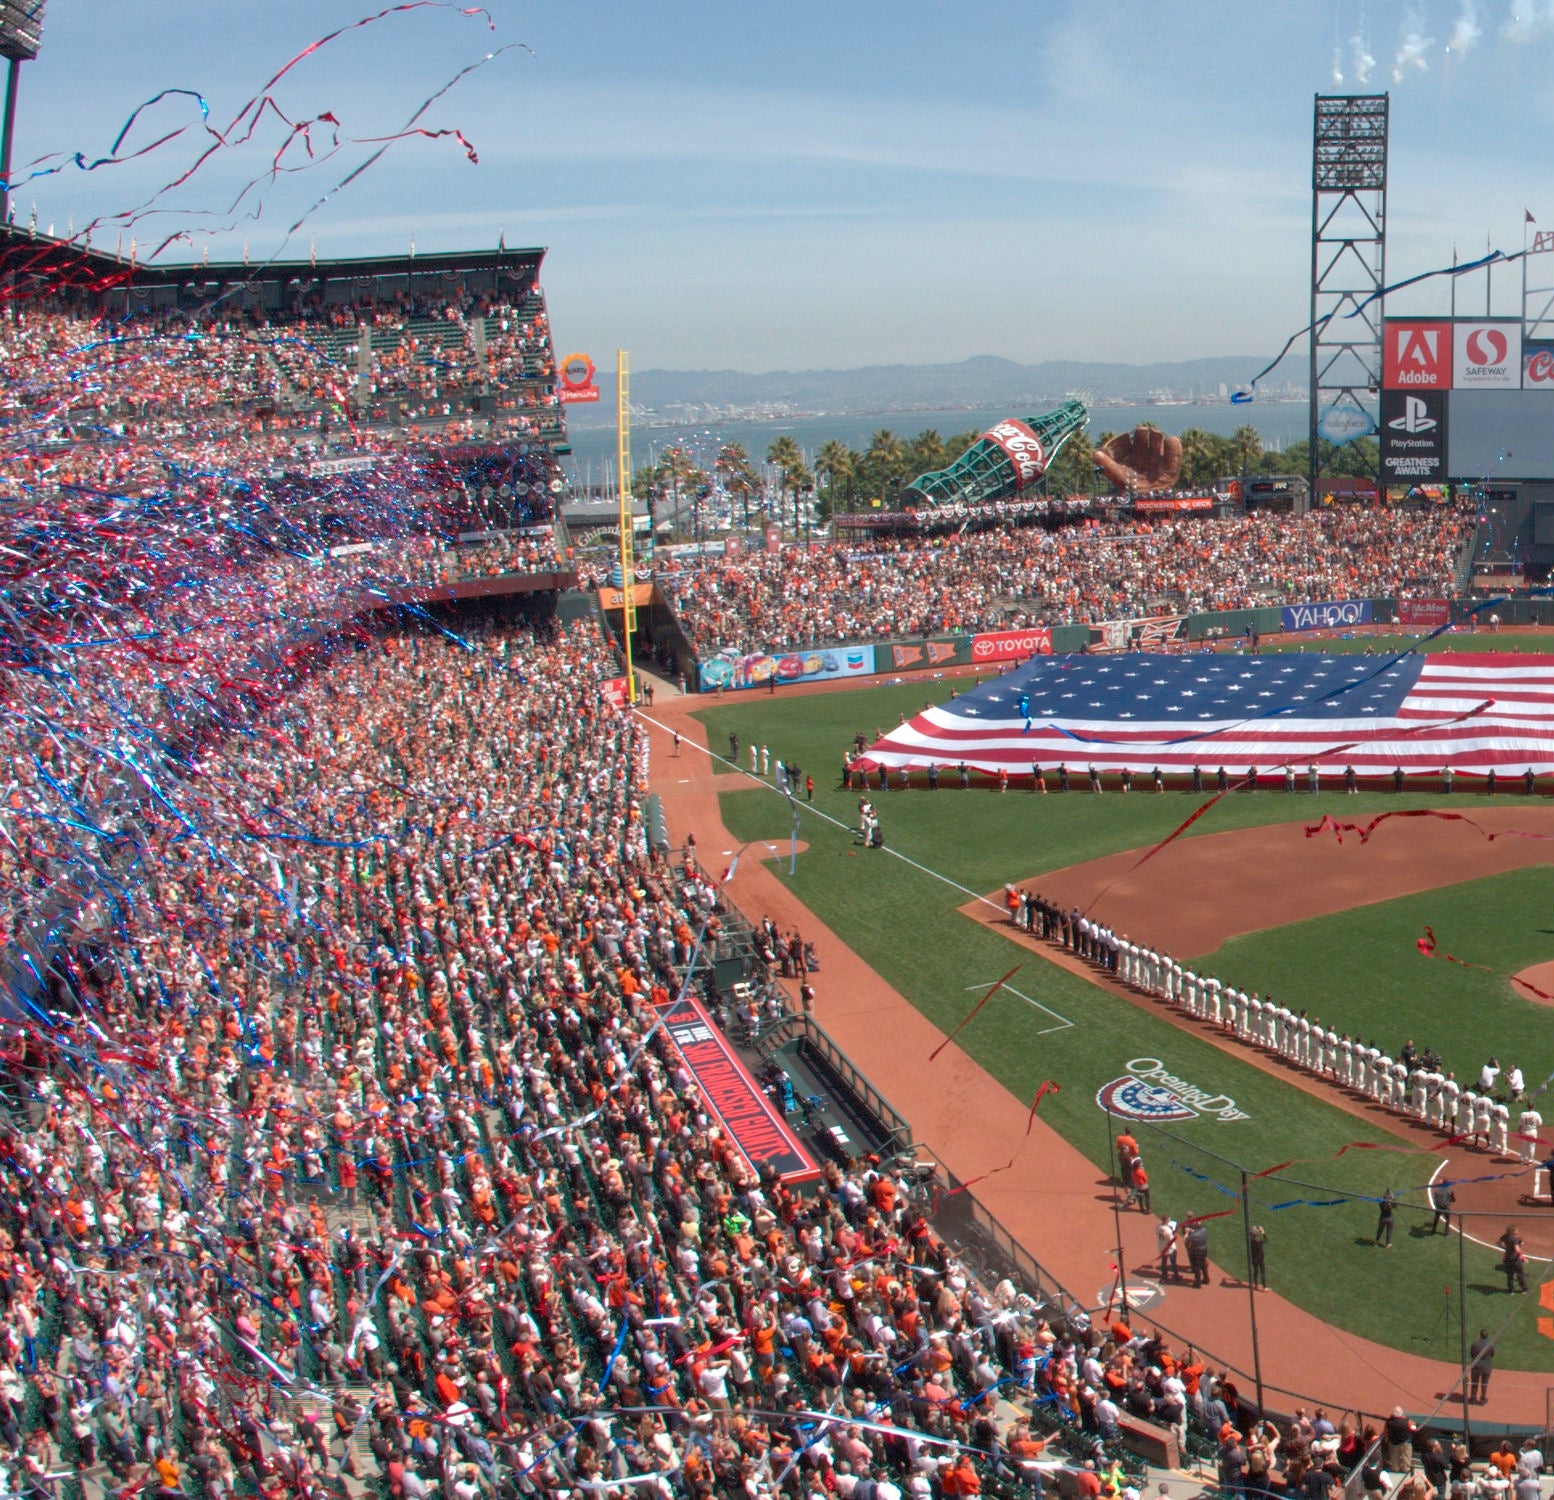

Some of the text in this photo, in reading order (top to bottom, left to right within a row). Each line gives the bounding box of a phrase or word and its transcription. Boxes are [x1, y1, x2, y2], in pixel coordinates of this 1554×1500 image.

[1398, 369, 1437, 384] Adobe
[1465, 367, 1507, 376] SAFEWAY
[1391, 439, 1435, 450] PlayStation
[1385, 457, 1440, 467] GREATNESS
[1394, 466, 1432, 475] AWAITS
[1137, 500, 1212, 510] DOCKERS DECK
[1412, 603, 1446, 613] McAfee
[1290, 603, 1363, 629] YAHOO!
[998, 636, 1051, 652] TOYOTA
[681, 1042, 724, 1068] SAN
[697, 1061, 762, 1119] FRANCISCO
[1125, 1057, 1251, 1121] Opening Day
[1524, 1117, 1534, 1126] 15
[729, 1115, 791, 1160] GIANTS
